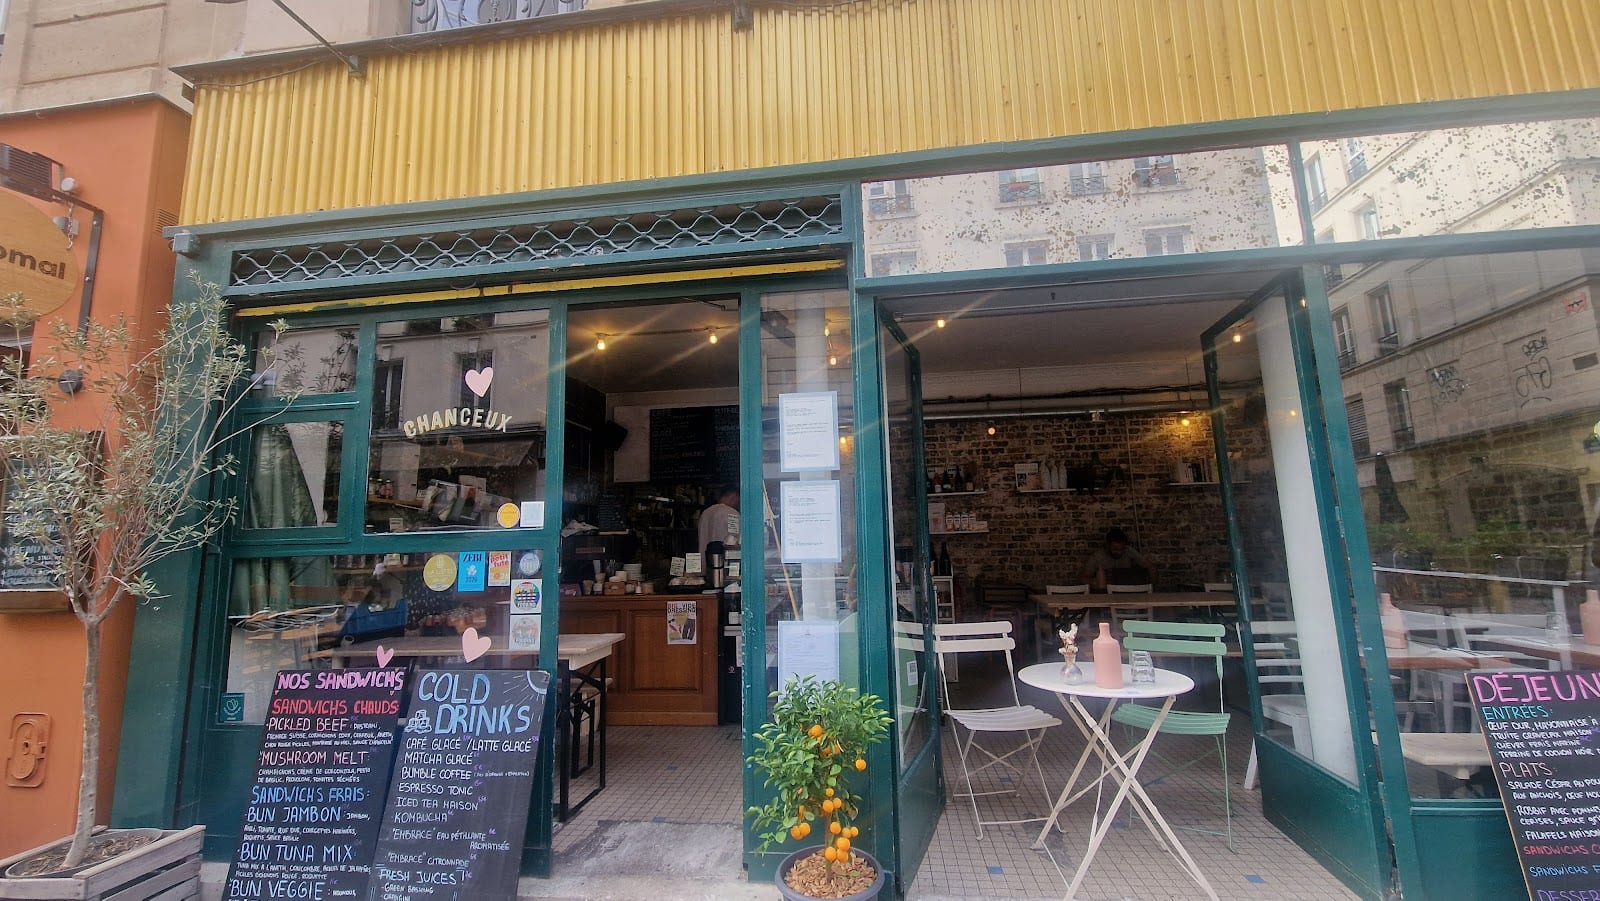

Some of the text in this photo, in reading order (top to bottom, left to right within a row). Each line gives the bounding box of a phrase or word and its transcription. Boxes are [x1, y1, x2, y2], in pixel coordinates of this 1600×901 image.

[403, 407, 513, 439] CHANCEUX
[277, 671, 405, 691] NOS SANDWICHS
[418, 671, 491, 705] COLD
[271, 698, 347, 715] SANDWICHS
[268, 717, 311, 732] PICKLED
[434, 703, 531, 736] DRINKS
[406, 736, 427, 750] CAFÉ
[431, 736, 461, 751] GLACÉ
[501, 738, 532, 753] GLACÉ
[260, 751, 327, 766] MUSHROOM
[404, 752, 442, 765] MATCHA
[445, 752, 473, 765] GLACÉ
[439, 768, 473, 780] COFFEE
[398, 782, 444, 796] ESPRESSO
[447, 785, 474, 796] TONIC
[1507, 780, 1543, 790] SALADE
[250, 785, 323, 805] SANDWICHS
[395, 796, 419, 808] ICED
[422, 798, 439, 809] TEA
[246, 806, 276, 823] BUN
[282, 806, 342, 823] JAMBON
[394, 811, 448, 824] KOMBUCHA
[1549, 806, 1570, 816] AVEC
[240, 842, 271, 862] BUN
[275, 843, 315, 862] TUNA
[1522, 844, 1589, 856] SANDWICHS
[378, 868, 411, 882] FRESH
[1528, 864, 1589, 877] SANDWICHS
[230, 879, 262, 897] BUN
